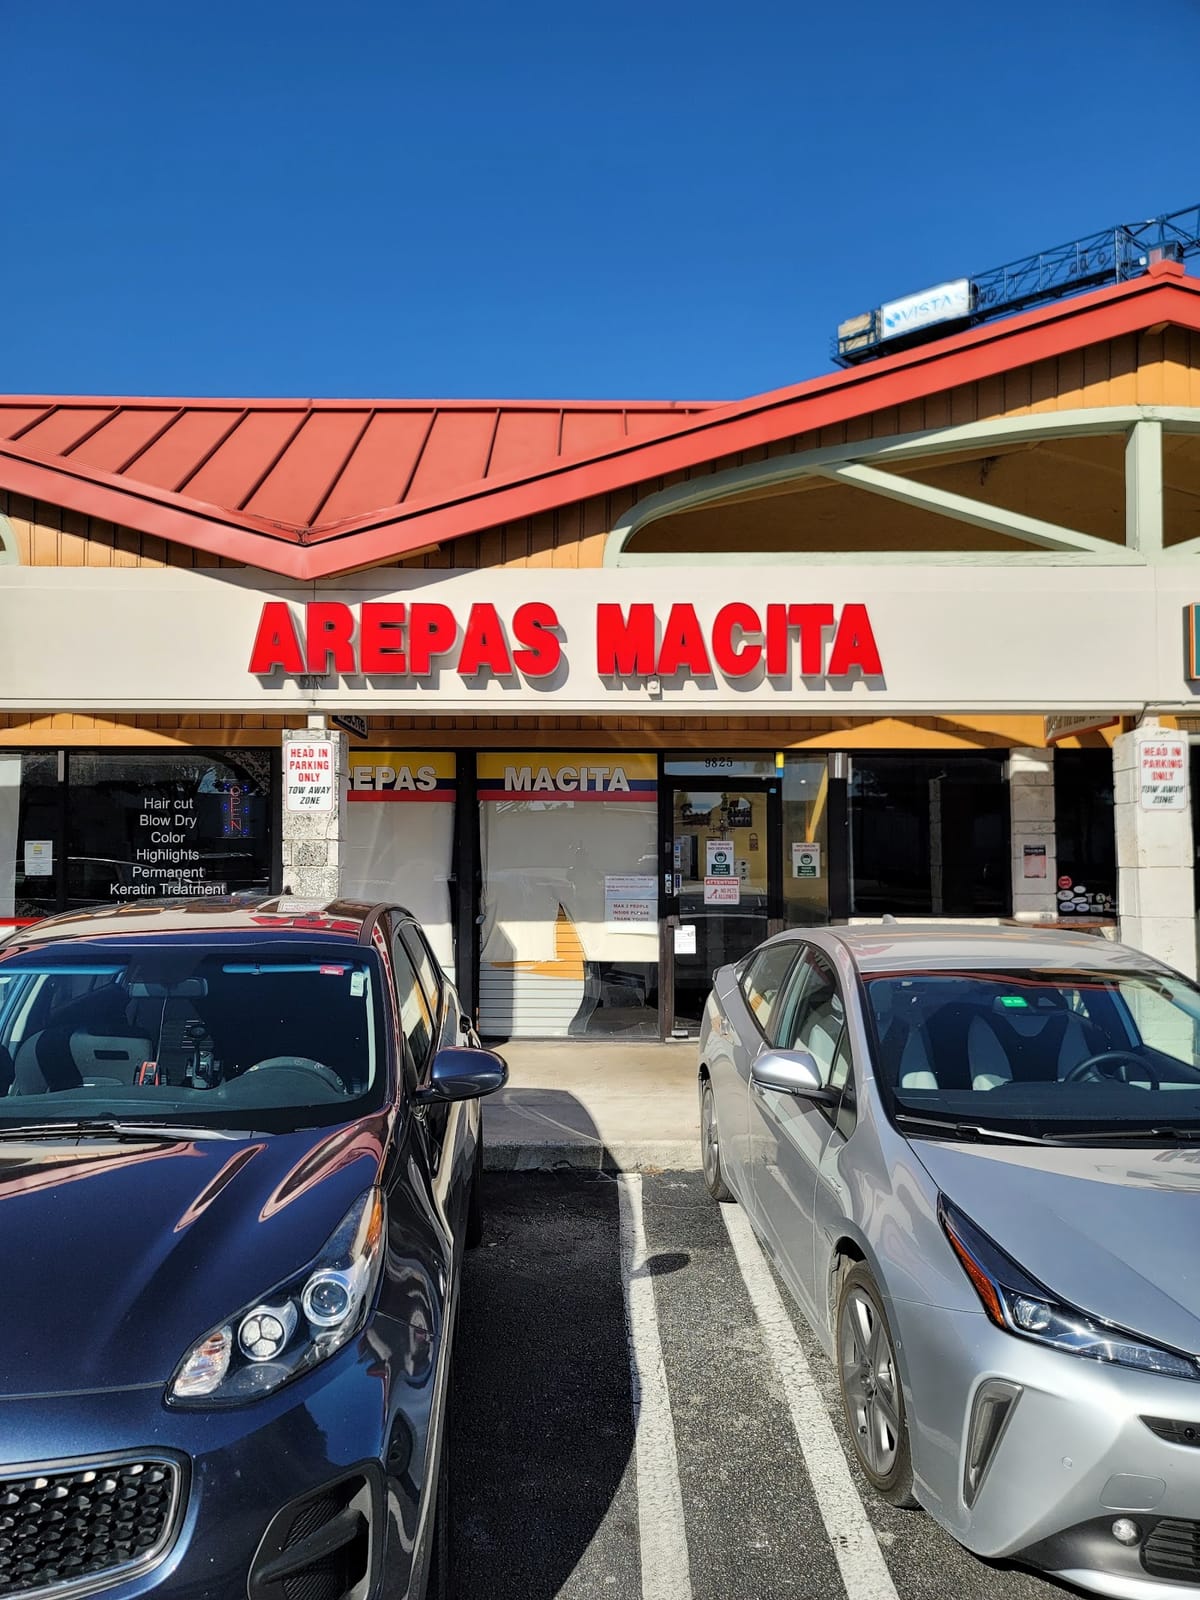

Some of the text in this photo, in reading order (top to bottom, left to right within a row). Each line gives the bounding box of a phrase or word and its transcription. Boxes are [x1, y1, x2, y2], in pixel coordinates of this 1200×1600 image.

[901, 295, 952, 321] VISTA
[248, 602, 884, 677] AREPAS MACITA
[290, 748, 328, 758] HEAD IN
[1143, 746, 1182, 756] HEAD IN
[289, 760, 329, 770] PARKING
[704, 758, 733, 769] 9825
[1142, 759, 1183, 769] PARKING
[298, 773, 320, 782] ONLY
[348, 766, 630, 792] EPAS MACITA
[1151, 771, 1174, 781] ONLY
[288, 786, 331, 794] TOW AWAY
[1141, 785, 1185, 793] TOW AWAY
[144, 798, 193, 809] Hair cut
[299, 796, 321, 805] ZONE
[1151, 795, 1175, 804] ZONE
[230, 785, 241, 831] OPEN
[140, 814, 197, 829] Blow Dry
[151, 831, 186, 843] Color
[136, 849, 200, 862] Highlights
[132, 867, 204, 878] Permanent
[110, 883, 225, 895] Keratin Treatment
